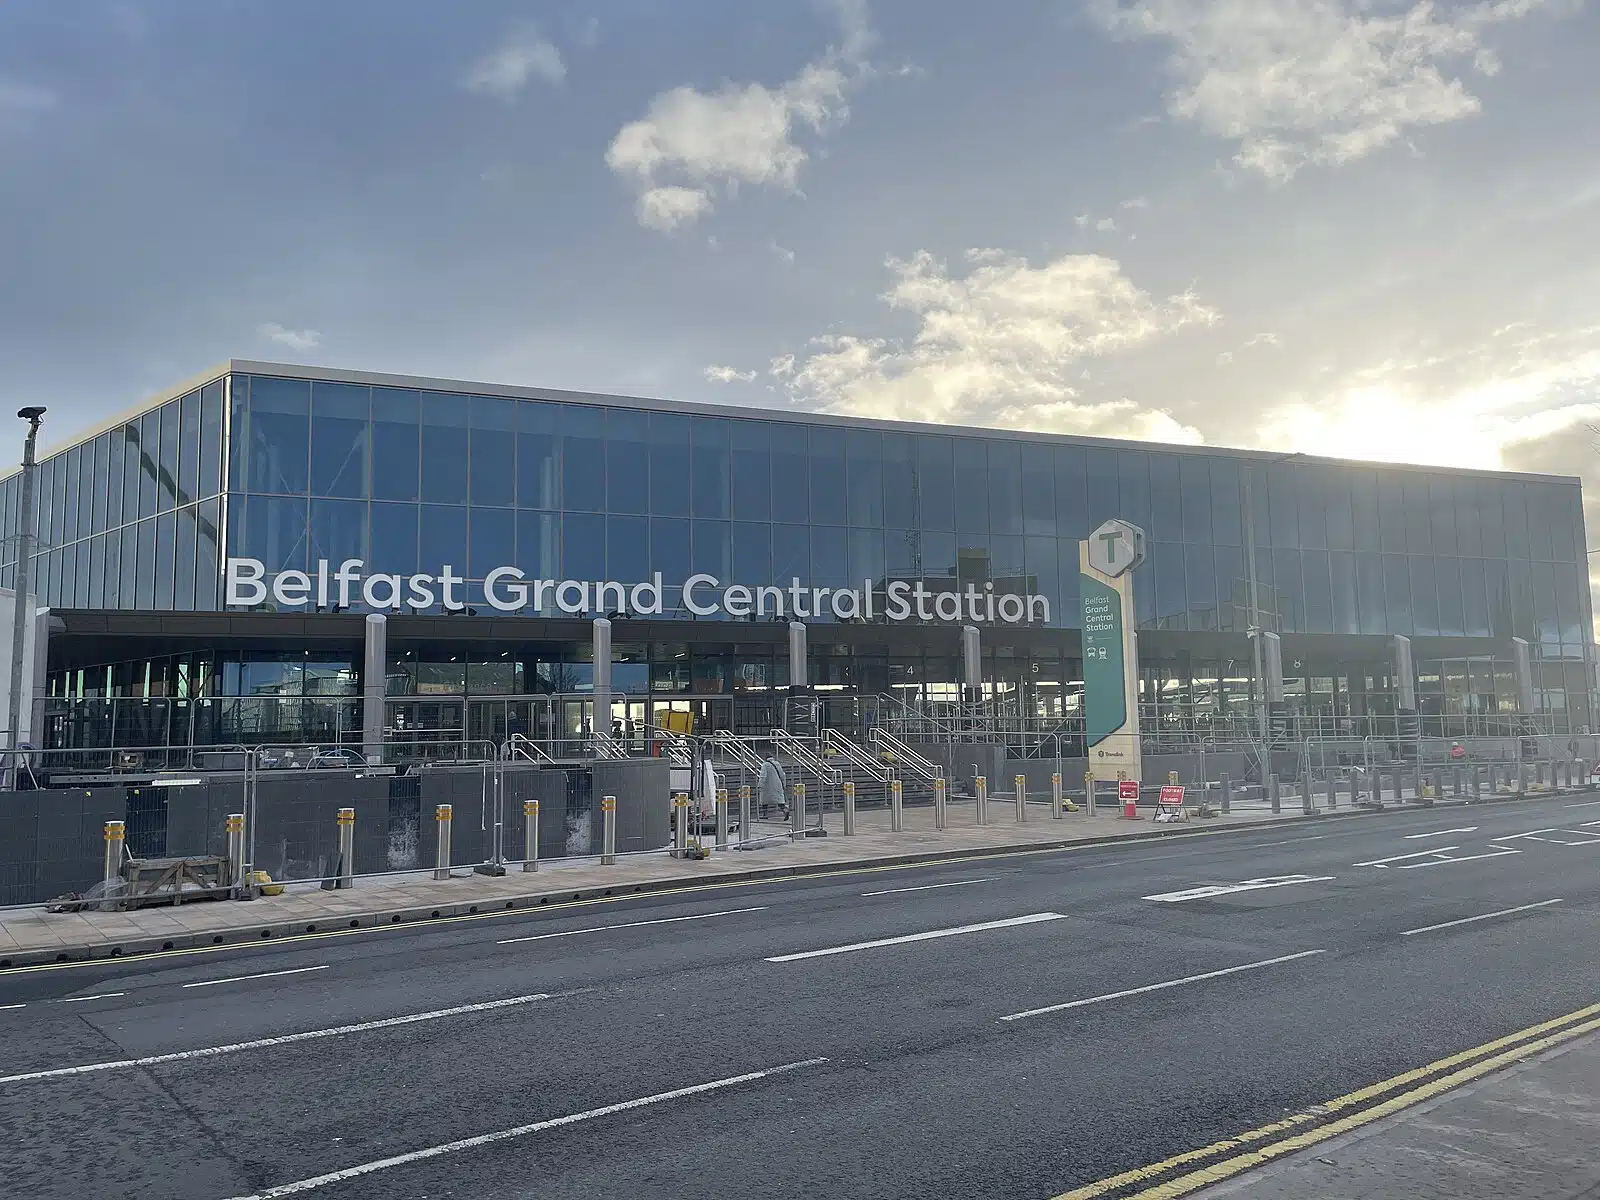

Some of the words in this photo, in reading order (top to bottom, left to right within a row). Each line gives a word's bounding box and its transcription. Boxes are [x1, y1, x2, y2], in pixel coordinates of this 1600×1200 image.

[1099, 531, 1122, 563] T
[226, 557, 464, 610] Belfast
[483, 566, 663, 614] Grand
[682, 573, 873, 619] Central
[884, 581, 1051, 623] Station
[1085, 596, 1109, 605] Belfast
[1085, 605, 1108, 613] Grand
[1086, 613, 1114, 622] Central
[1086, 622, 1114, 632] Station
[1032, 663, 1039, 673] 5
[1227, 659, 1234, 670] 7
[906, 665, 914, 675] 4
[667, 671, 672, 680] 1
